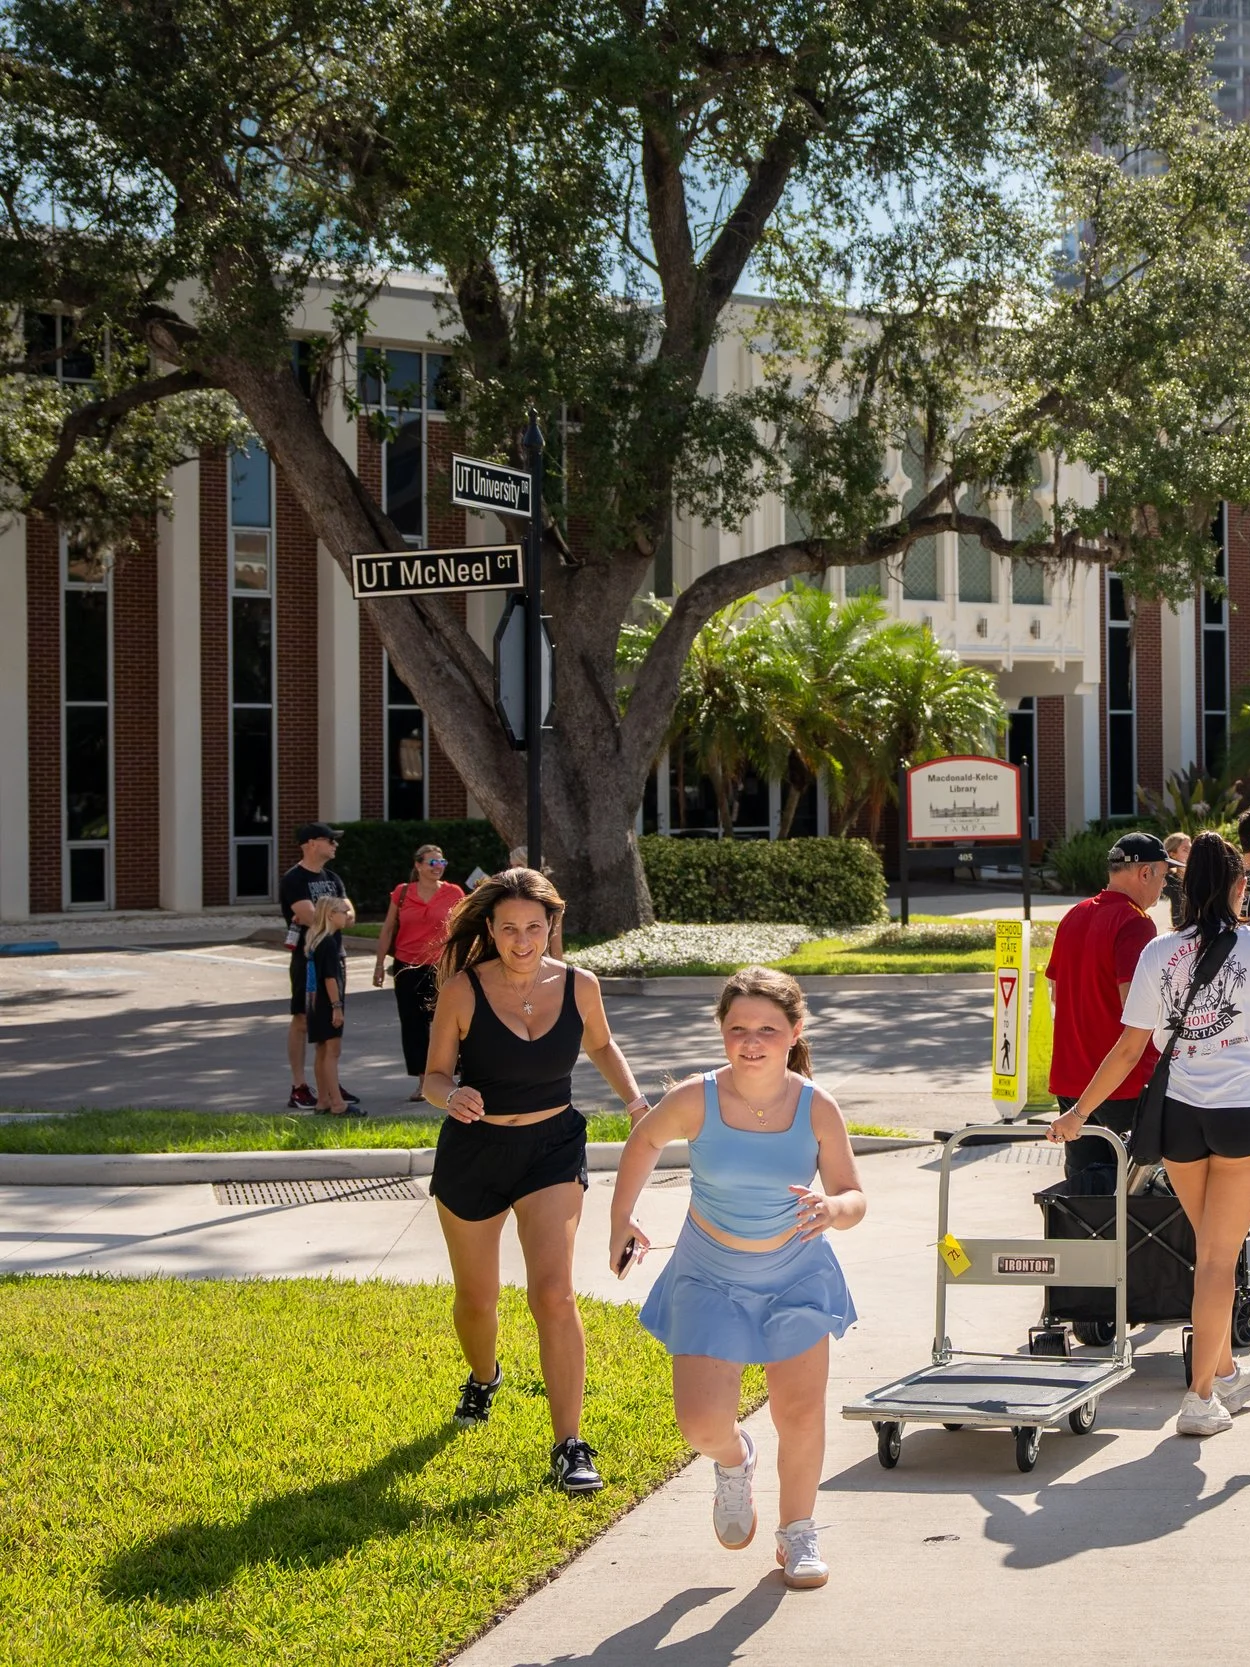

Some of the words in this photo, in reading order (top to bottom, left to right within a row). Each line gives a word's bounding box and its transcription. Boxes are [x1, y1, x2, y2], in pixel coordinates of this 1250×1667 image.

[456, 463, 471, 493] UT
[472, 470, 521, 508] University
[521, 480, 529, 494] DR
[361, 561, 393, 588] UT
[400, 556, 491, 586] McNeel
[497, 554, 513, 570] CT
[927, 773, 998, 783] Macdonald-Kelce
[949, 785, 977, 794] Library
[958, 853, 973, 861] 405
[997, 924, 1021, 935] SCHOOL
[1000, 942, 1017, 953] STATE
[1002, 955, 1014, 965] LAW
[1183, 1012, 1217, 1027] HOME
[1179, 1015, 1232, 1039] PARTANS
[947, 1249, 961, 1261] 71
[1004, 1259, 1049, 1272] IRONTON
